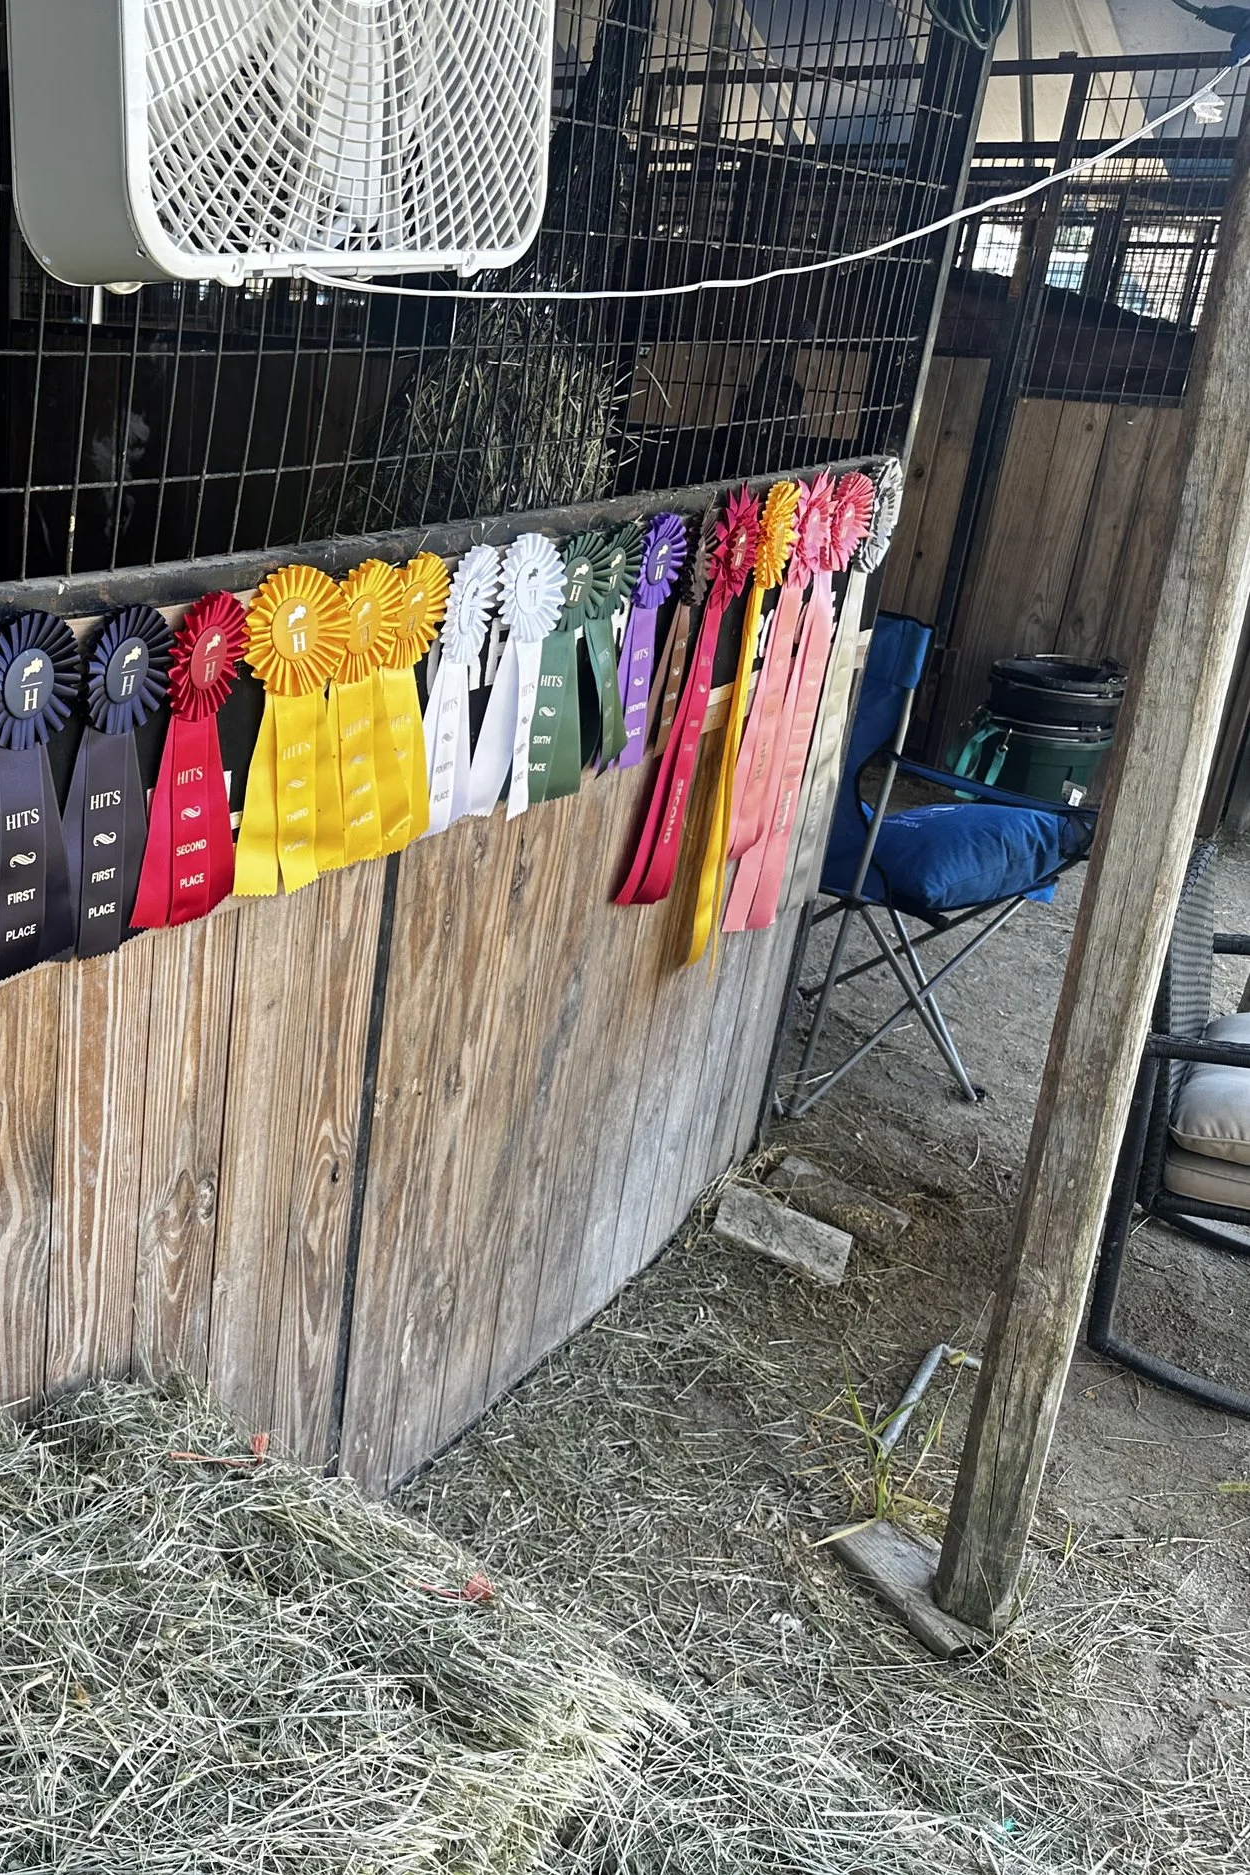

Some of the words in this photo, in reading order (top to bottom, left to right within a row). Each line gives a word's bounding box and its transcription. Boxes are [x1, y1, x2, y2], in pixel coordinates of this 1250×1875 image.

[568, 585, 582, 602] H
[292, 631, 307, 654] H
[204, 660, 217, 682] H
[120, 674, 136, 696] H
[540, 675, 564, 688] HITS
[23, 687, 40, 712] H
[532, 735, 552, 745] SIXTH
[177, 766, 204, 786] HITS
[90, 789, 122, 811] HITS
[5, 808, 40, 832] HITS
[286, 807, 309, 824] THIRD
[350, 810, 375, 828] PLACE
[663, 778, 684, 844] SECOND
[176, 838, 207, 857] SECOND
[91, 867, 116, 884] FIRST
[179, 873, 206, 889] PLACE
[7, 888, 37, 905] FIRST
[88, 902, 116, 919] PLACE
[5, 923, 37, 942] PLACE
